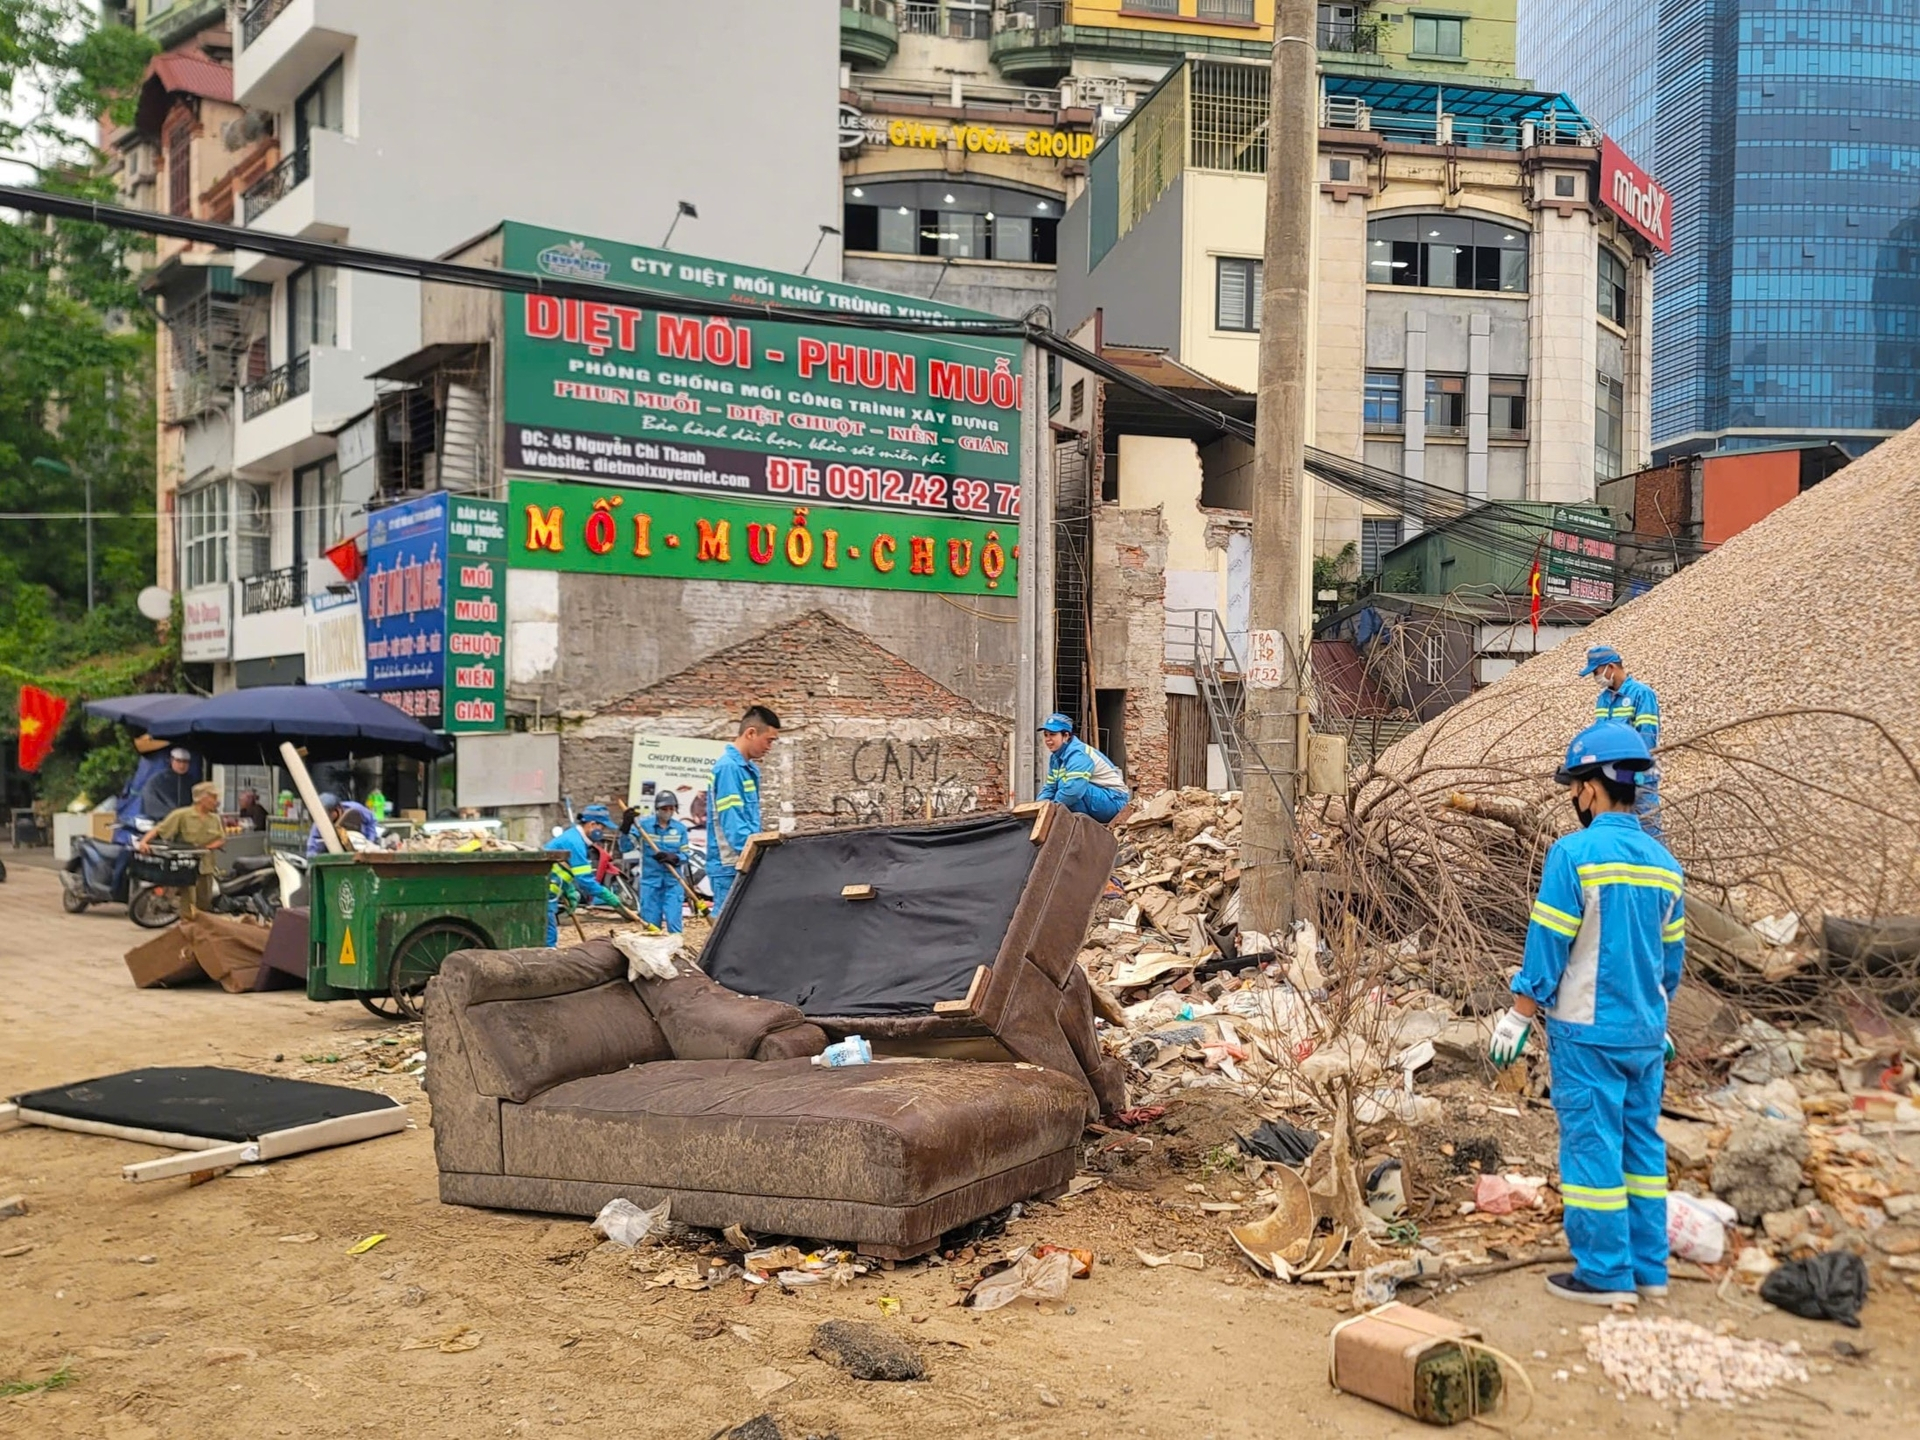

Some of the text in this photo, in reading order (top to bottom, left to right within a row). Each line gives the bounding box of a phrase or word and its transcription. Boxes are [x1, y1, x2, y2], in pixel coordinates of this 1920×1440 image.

[889, 119, 1095, 160] GYM YOGA GROUP
[1613, 169, 1665, 241] mindX
[630, 257, 672, 277] CTY
[679, 265, 727, 290] DIỆT
[733, 275, 775, 296] MỐI
[780, 284, 824, 304] KHỬ
[827, 293, 891, 317] TRÙNG
[798, 336, 917, 394] PHUN
[568, 359, 999, 433] PHÒNG CHỐNG MỐI CÔNG TRÌNH XÂY DỰNG
[554, 380, 629, 405] PHUN
[634, 390, 701, 415] MUỖI
[727, 405, 784, 427] DIỆT
[788, 411, 866, 438] CHUỘT
[958, 436, 1009, 456] GIÁN
[641, 415, 679, 432] Bảo
[682, 415, 727, 439] hành
[731, 428, 763, 443] dài
[520, 429, 706, 465] ĐC: 45 Nguyễn Chí Thanh
[521, 449, 750, 488] Website: dietmoixuyenviet.com
[766, 456, 820, 496] ĐT:
[826, 464, 947, 508] 0912.42
[952, 478, 990, 513] 32
[461, 562, 493, 589] MỐI
[872, 530, 1019, 589] CHUỘ
[455, 595, 498, 622] MUỖI
[450, 631, 502, 659] CHUỘT
[456, 662, 495, 689] KIẾN
[455, 697, 495, 722] GIÁN
